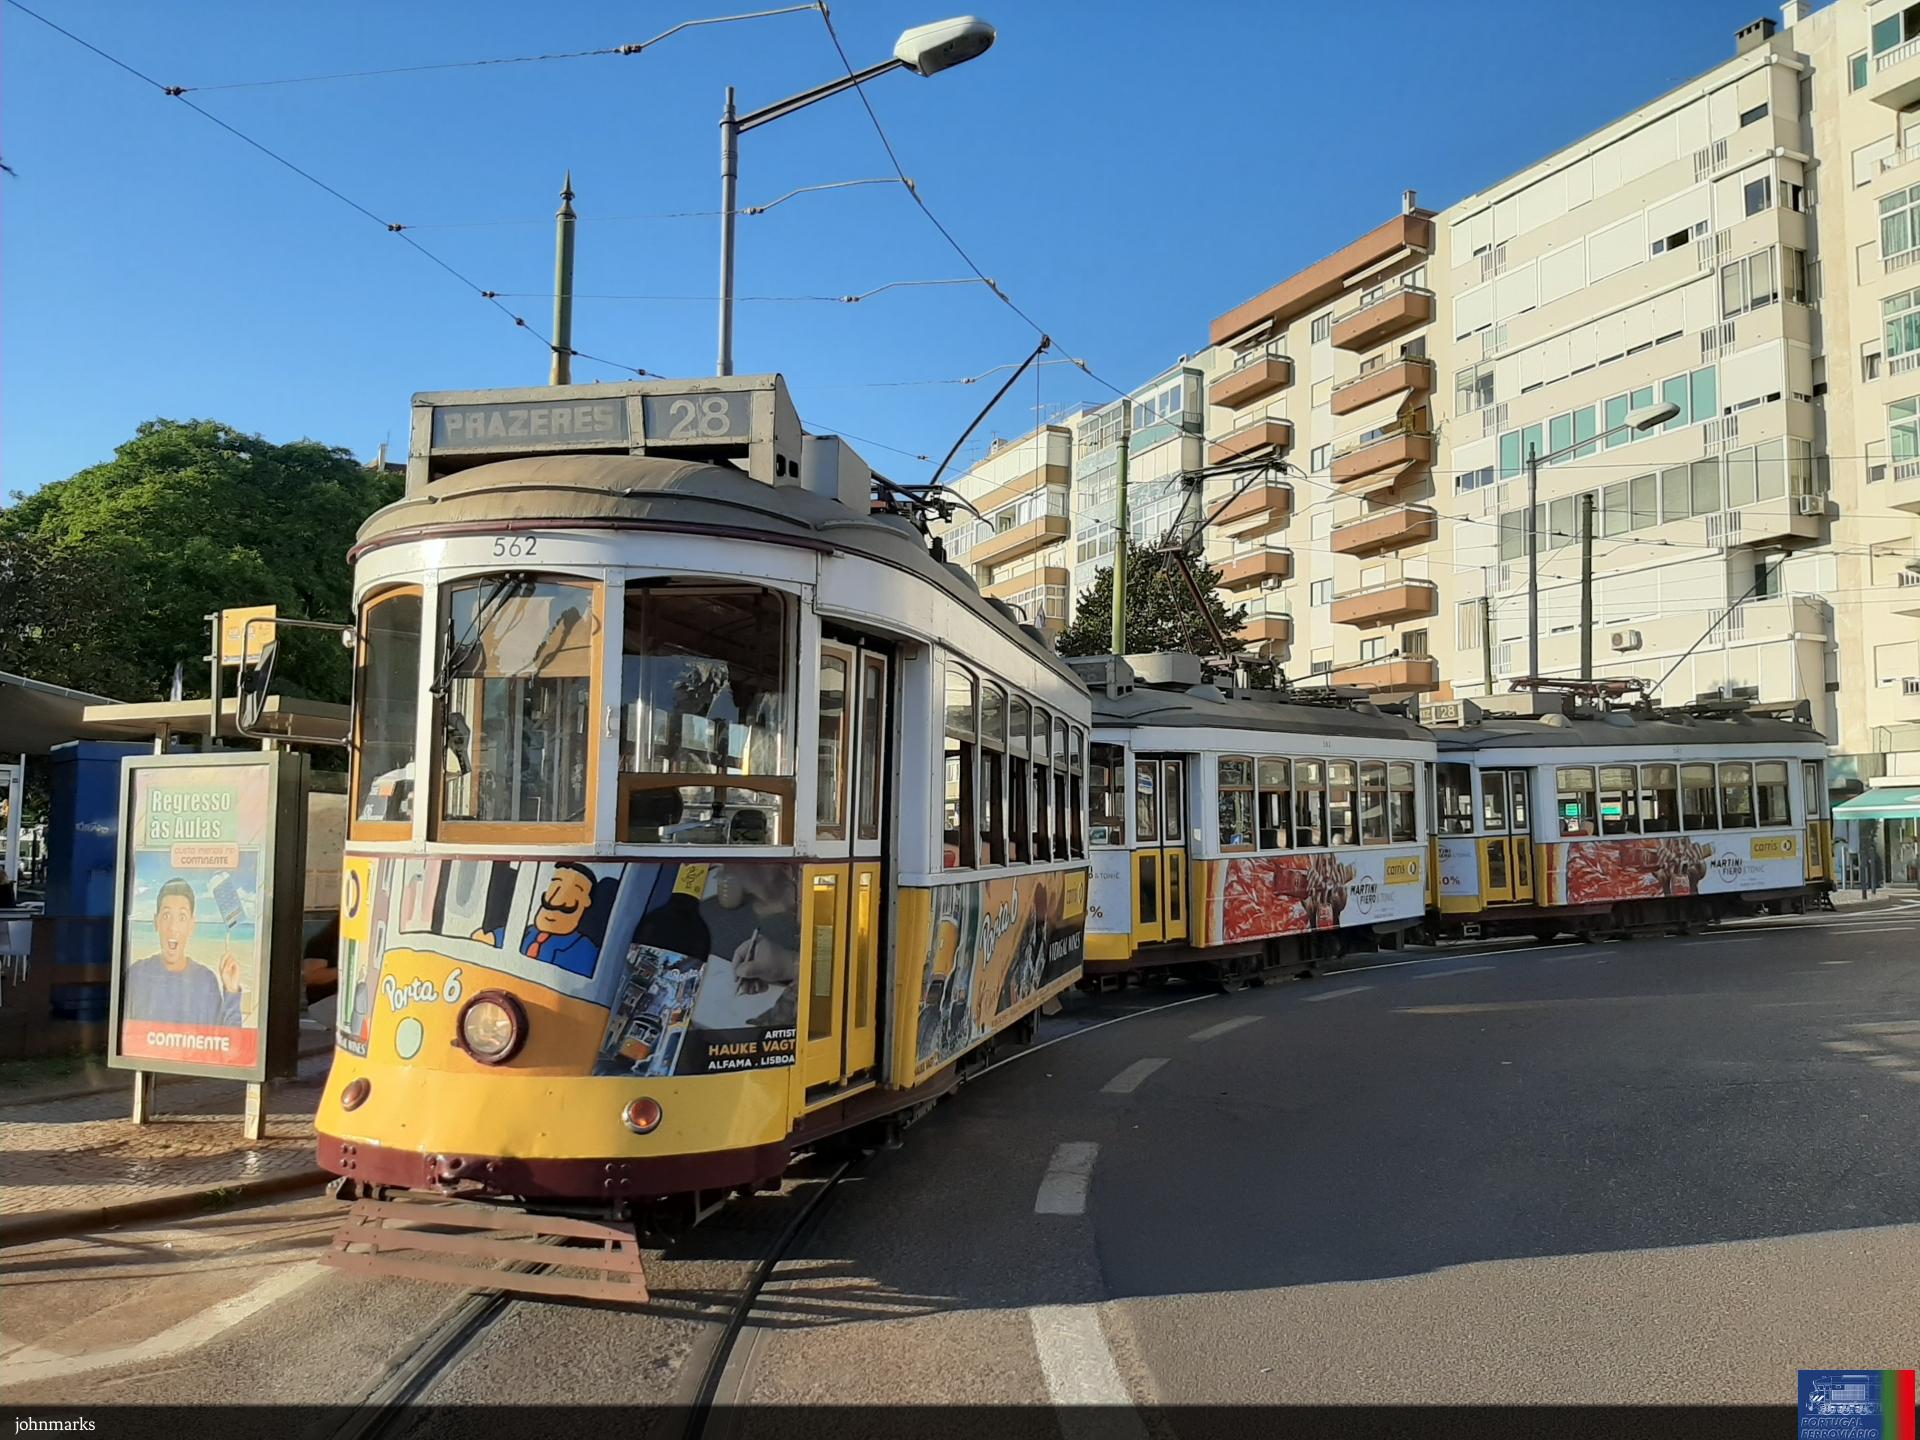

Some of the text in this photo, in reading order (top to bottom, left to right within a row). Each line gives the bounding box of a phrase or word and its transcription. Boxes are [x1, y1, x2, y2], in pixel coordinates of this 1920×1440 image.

[445, 397, 731, 440] PRAZERES 28
[493, 536, 537, 557] 562
[1440, 705, 1455, 718] 28
[152, 790, 231, 815] Regresso
[151, 816, 221, 839] às Aulas
[1754, 842, 1778, 852] carris
[1710, 858, 1743, 868] MARTINI
[1722, 867, 1743, 876] FIERO
[1351, 884, 1377, 895] MARTINI
[1360, 894, 1377, 905] FIERO
[382, 967, 463, 1012] Porta 6
[147, 1031, 230, 1051] CONTINENTE
[765, 1028, 796, 1039] ARTIST
[708, 1039, 796, 1057] HAUKE VAGT
[708, 1058, 752, 1070] ALFAMA
[761, 1054, 796, 1067] LISBOA
